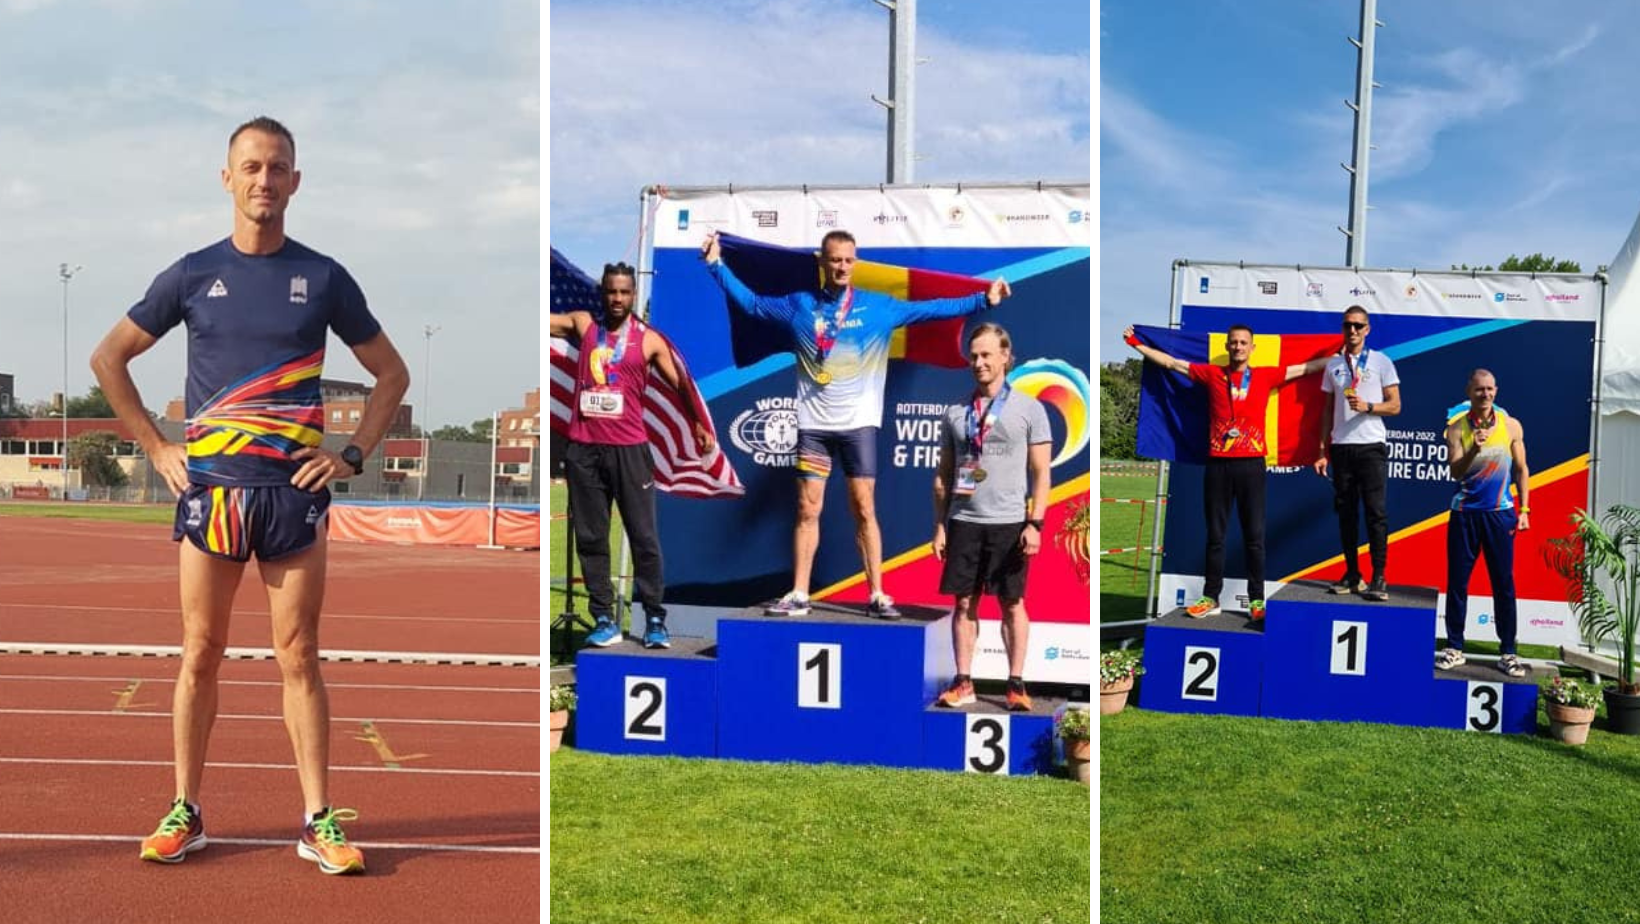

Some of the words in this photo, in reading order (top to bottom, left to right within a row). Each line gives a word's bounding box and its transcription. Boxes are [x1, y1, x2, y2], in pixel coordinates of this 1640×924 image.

[896, 403, 948, 416] ROTTERD
[896, 419, 942, 441] WOR
[1415, 431, 1436, 441] 2022
[753, 452, 798, 467] GAME
[894, 445, 907, 467] &
[1388, 462, 1412, 479] IRE
[1416, 463, 1456, 481] GAM
[1337, 625, 1359, 671] 1
[806, 649, 829, 702] 1
[1185, 652, 1217, 697] 2
[629, 683, 663, 735] 2
[1469, 686, 1500, 731] 3
[970, 719, 1006, 772] 3
